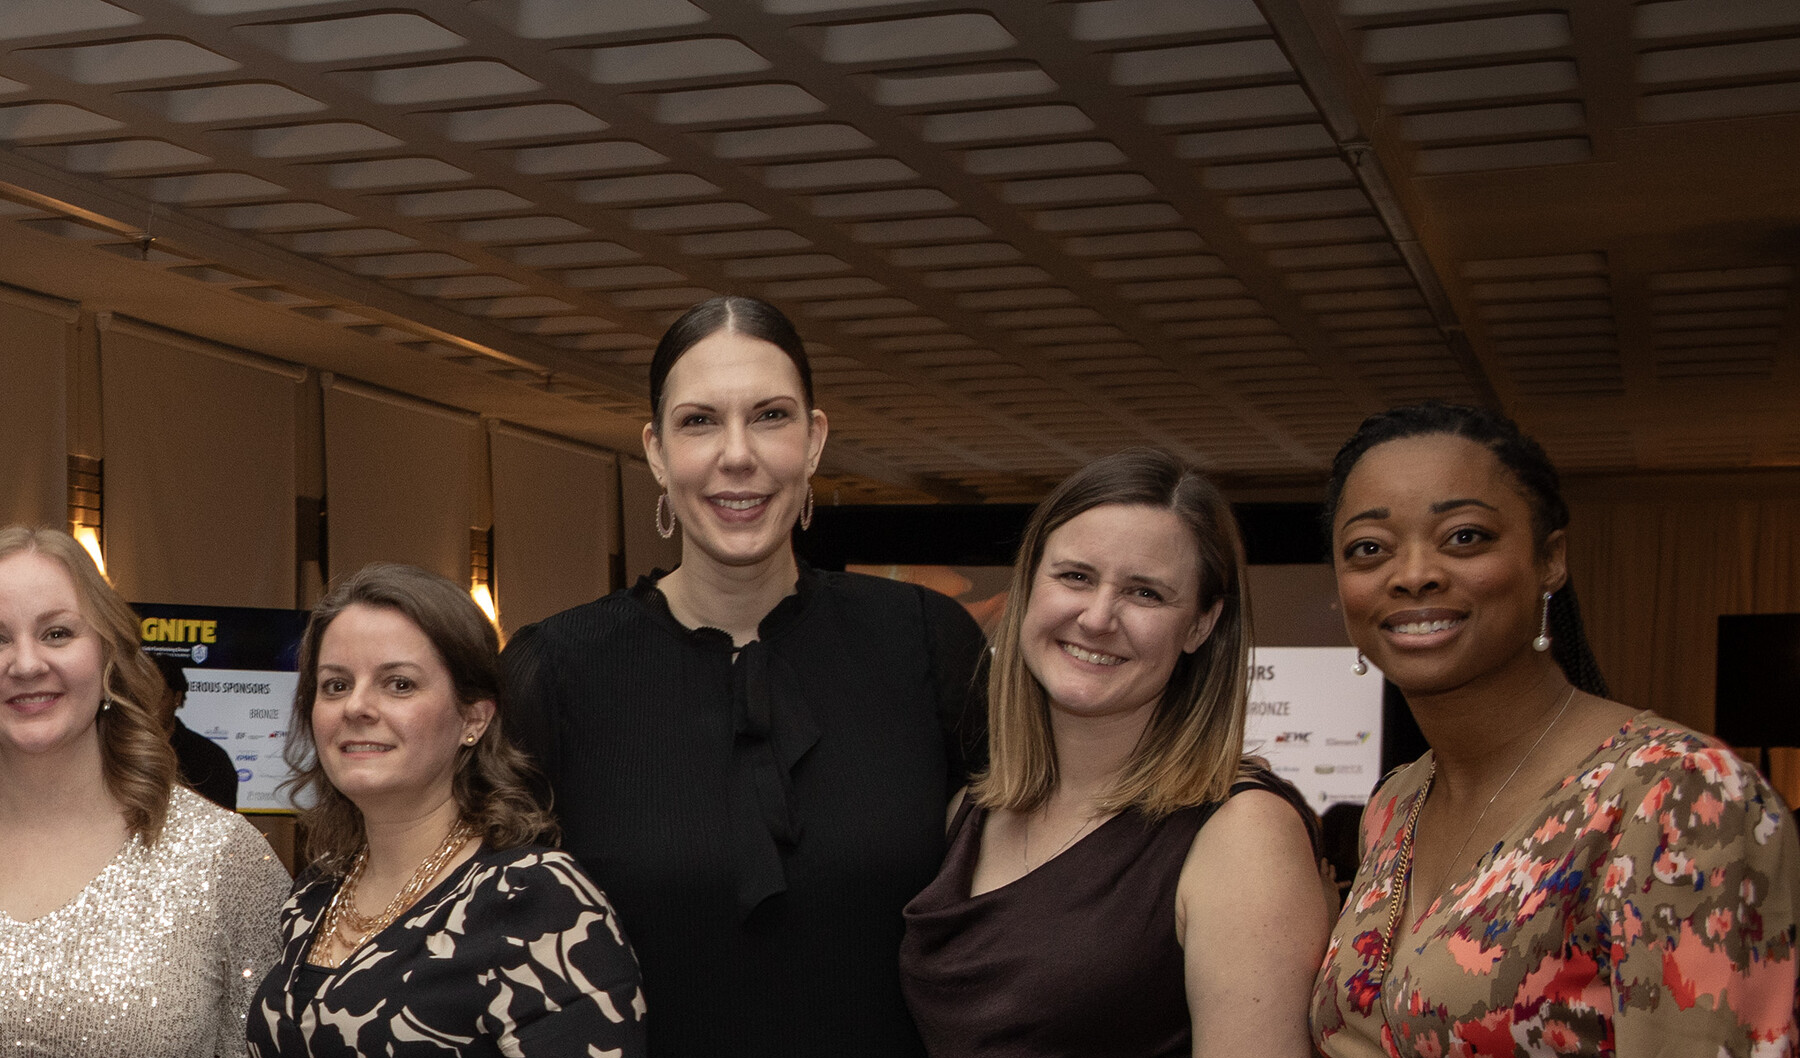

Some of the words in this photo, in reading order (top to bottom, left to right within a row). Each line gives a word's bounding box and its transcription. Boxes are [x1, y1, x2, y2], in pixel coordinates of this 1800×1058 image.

[141, 617, 217, 643] GNITE
[189, 681, 221, 693] EROUS
[222, 682, 271, 694] SPONSORS
[249, 708, 279, 719] BRONZE
